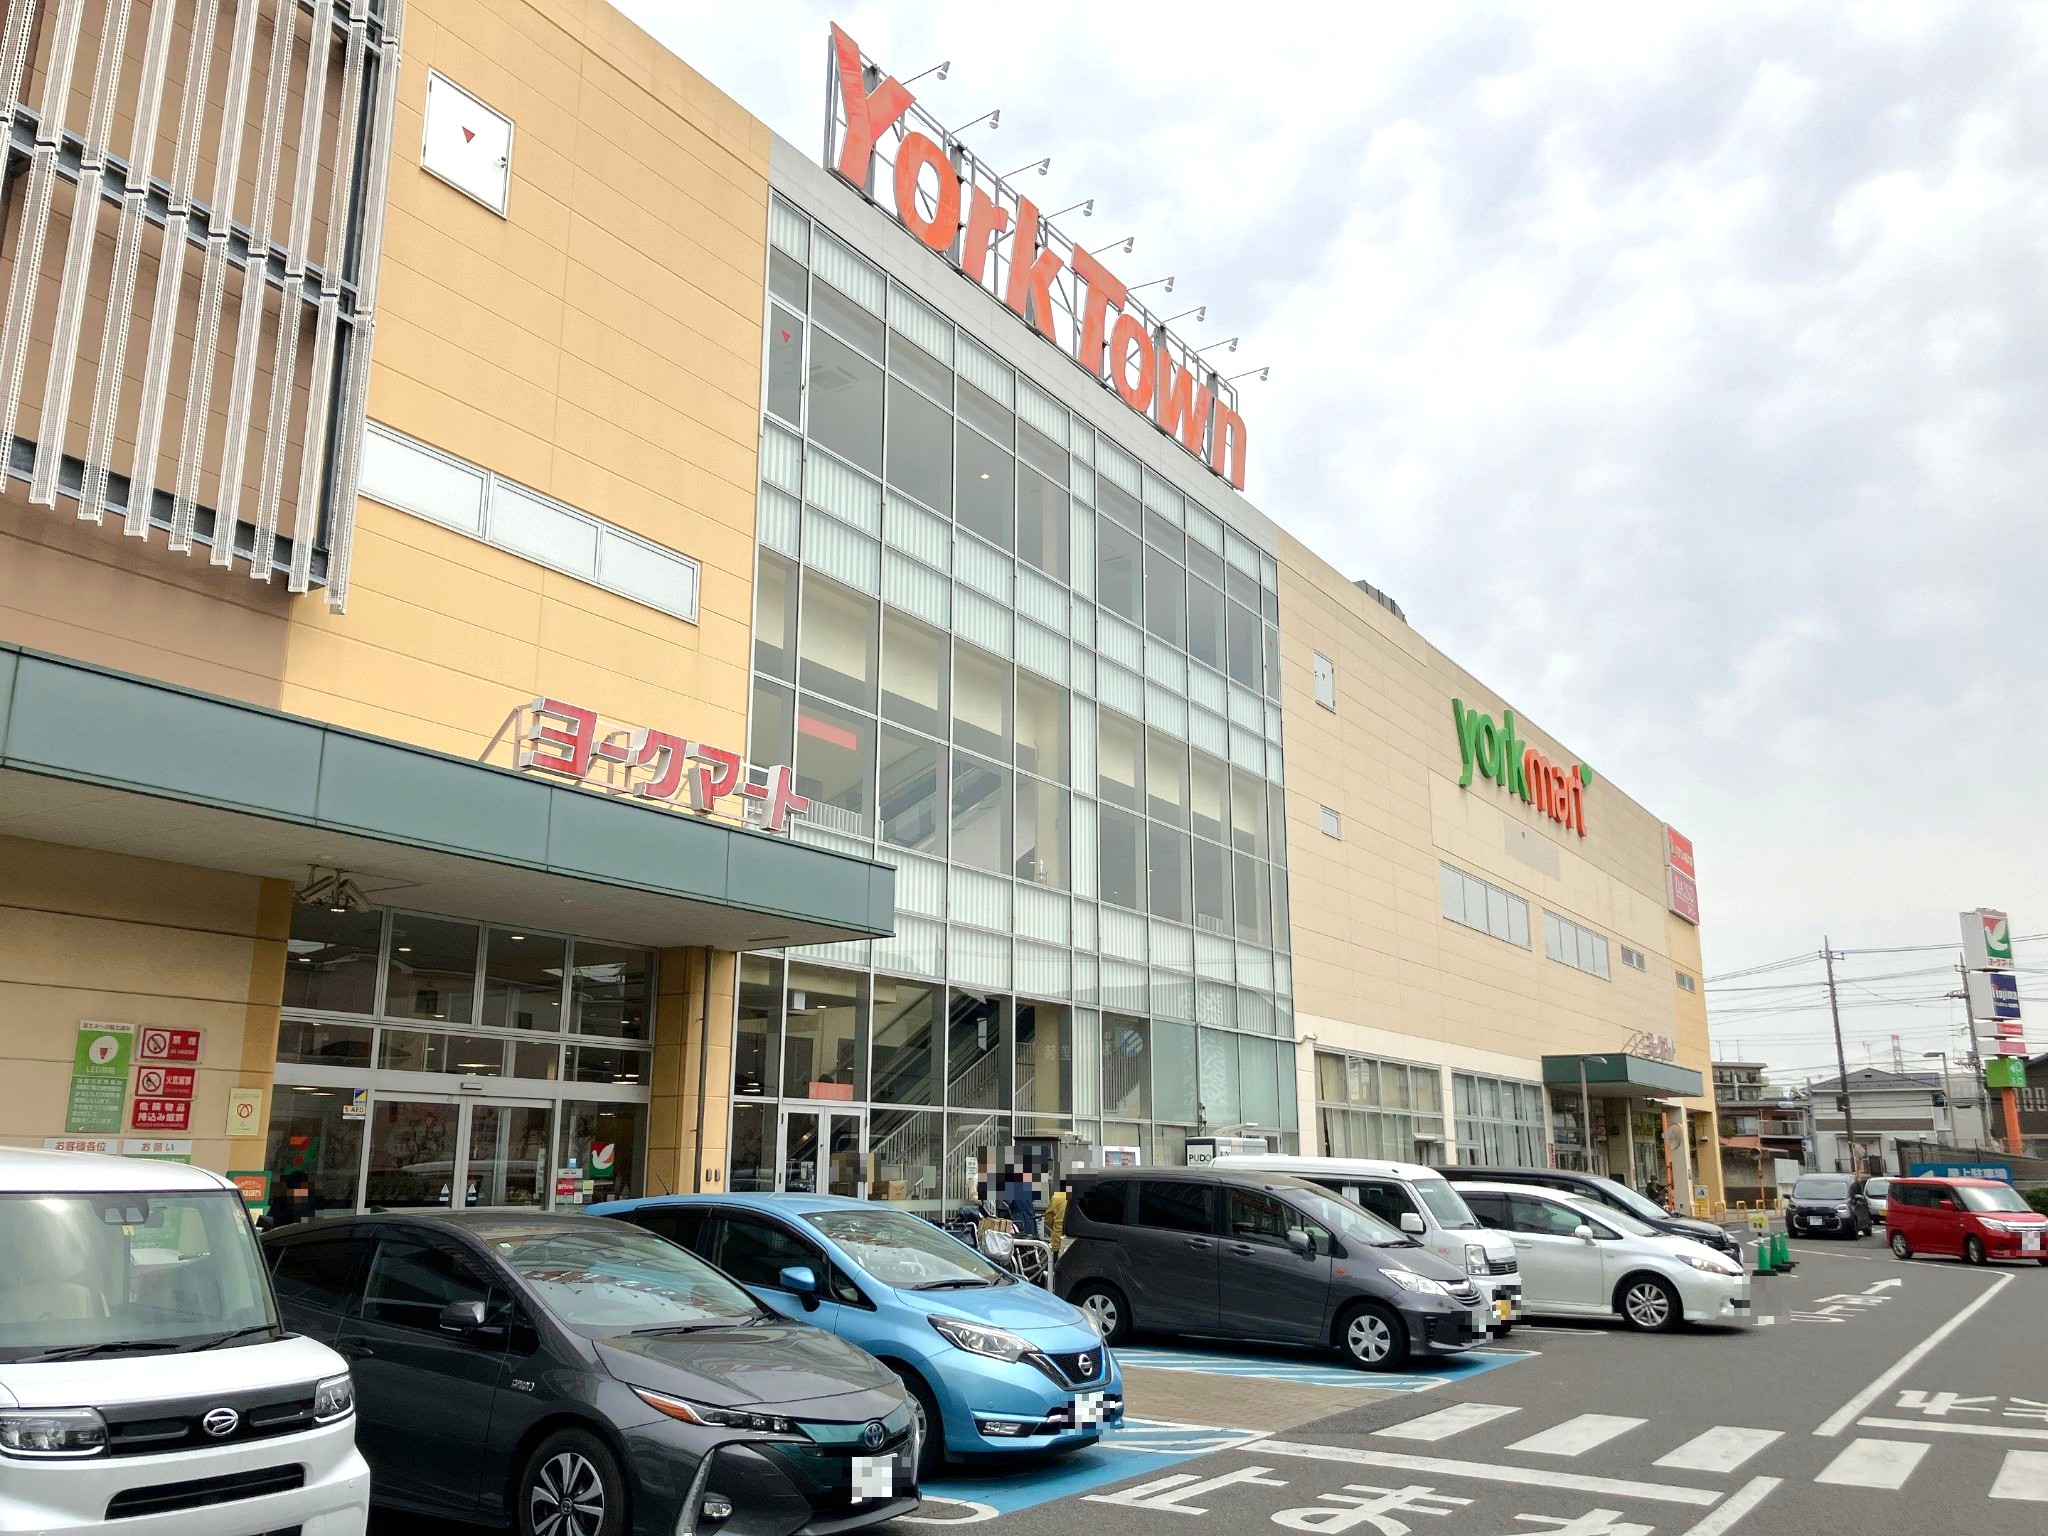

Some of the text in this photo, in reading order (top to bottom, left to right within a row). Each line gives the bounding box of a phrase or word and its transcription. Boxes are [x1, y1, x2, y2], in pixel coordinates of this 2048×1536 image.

[519, 695, 809, 833] ヨークマート
[139, 1102, 186, 1112] 危険物品
[137, 1112, 185, 1122] 持込み厳禁
[55, 1141, 106, 1152] お客様各位
[141, 1142, 175, 1152] お願い
[1188, 1153, 1212, 1162] PUDO
